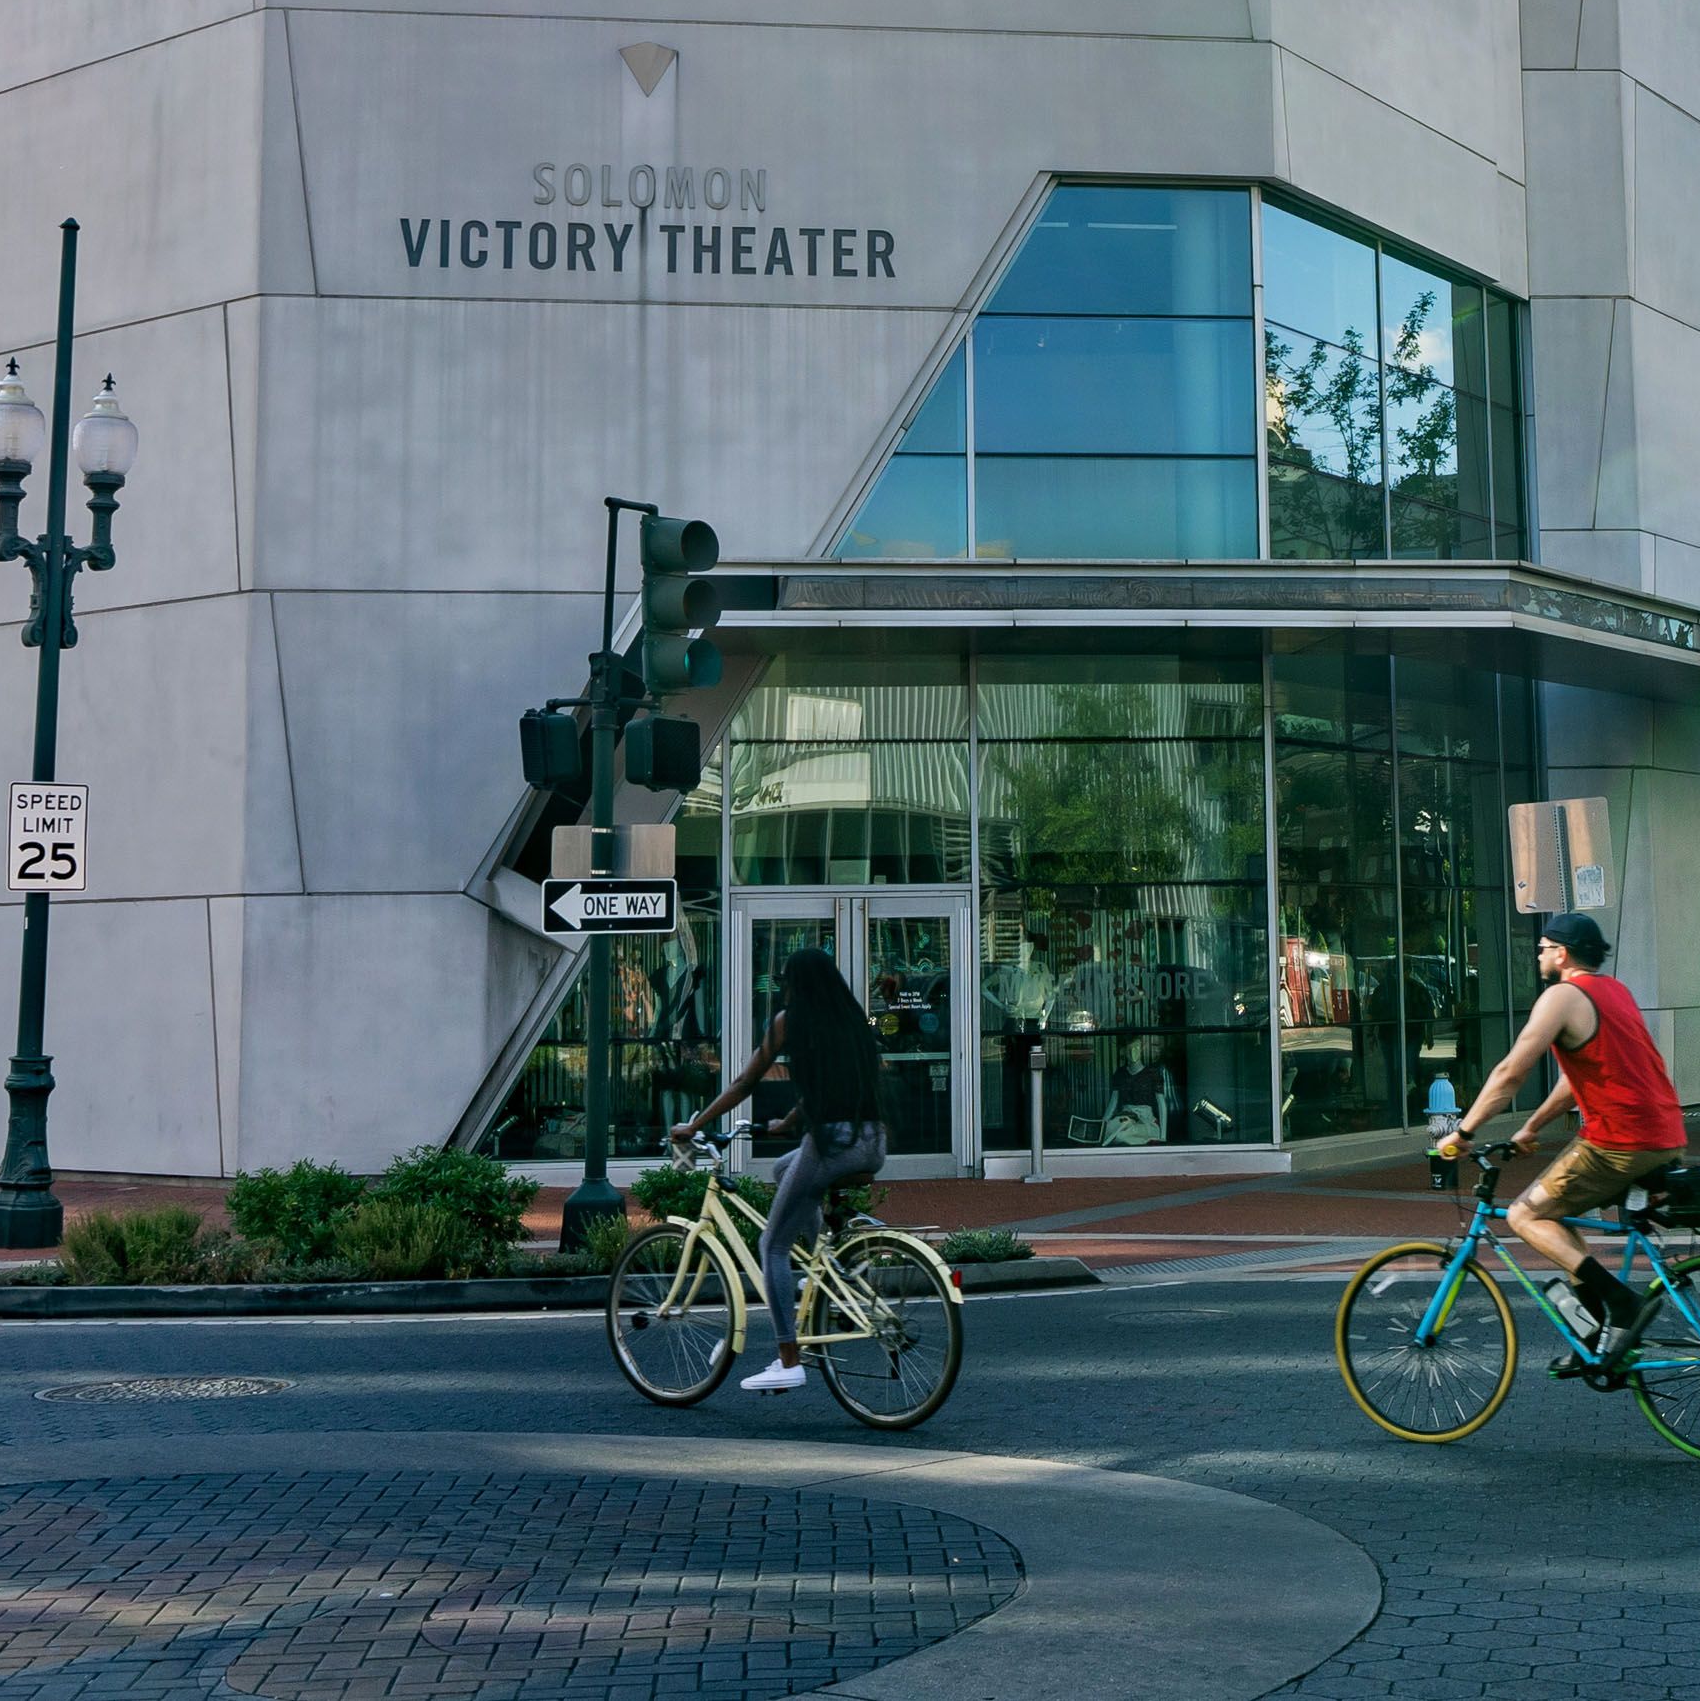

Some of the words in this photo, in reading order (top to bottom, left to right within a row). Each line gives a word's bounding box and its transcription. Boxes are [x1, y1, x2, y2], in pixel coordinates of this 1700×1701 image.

[532, 162, 767, 212] SOLOMON
[399, 218, 634, 273] VICTORY
[658, 224, 897, 278] THEATER
[16, 793, 83, 811] SPEED
[23, 816, 74, 834] LIMIT
[17, 841, 77, 881] 25
[583, 896, 619, 916] ONE
[625, 895, 661, 916] WAY
